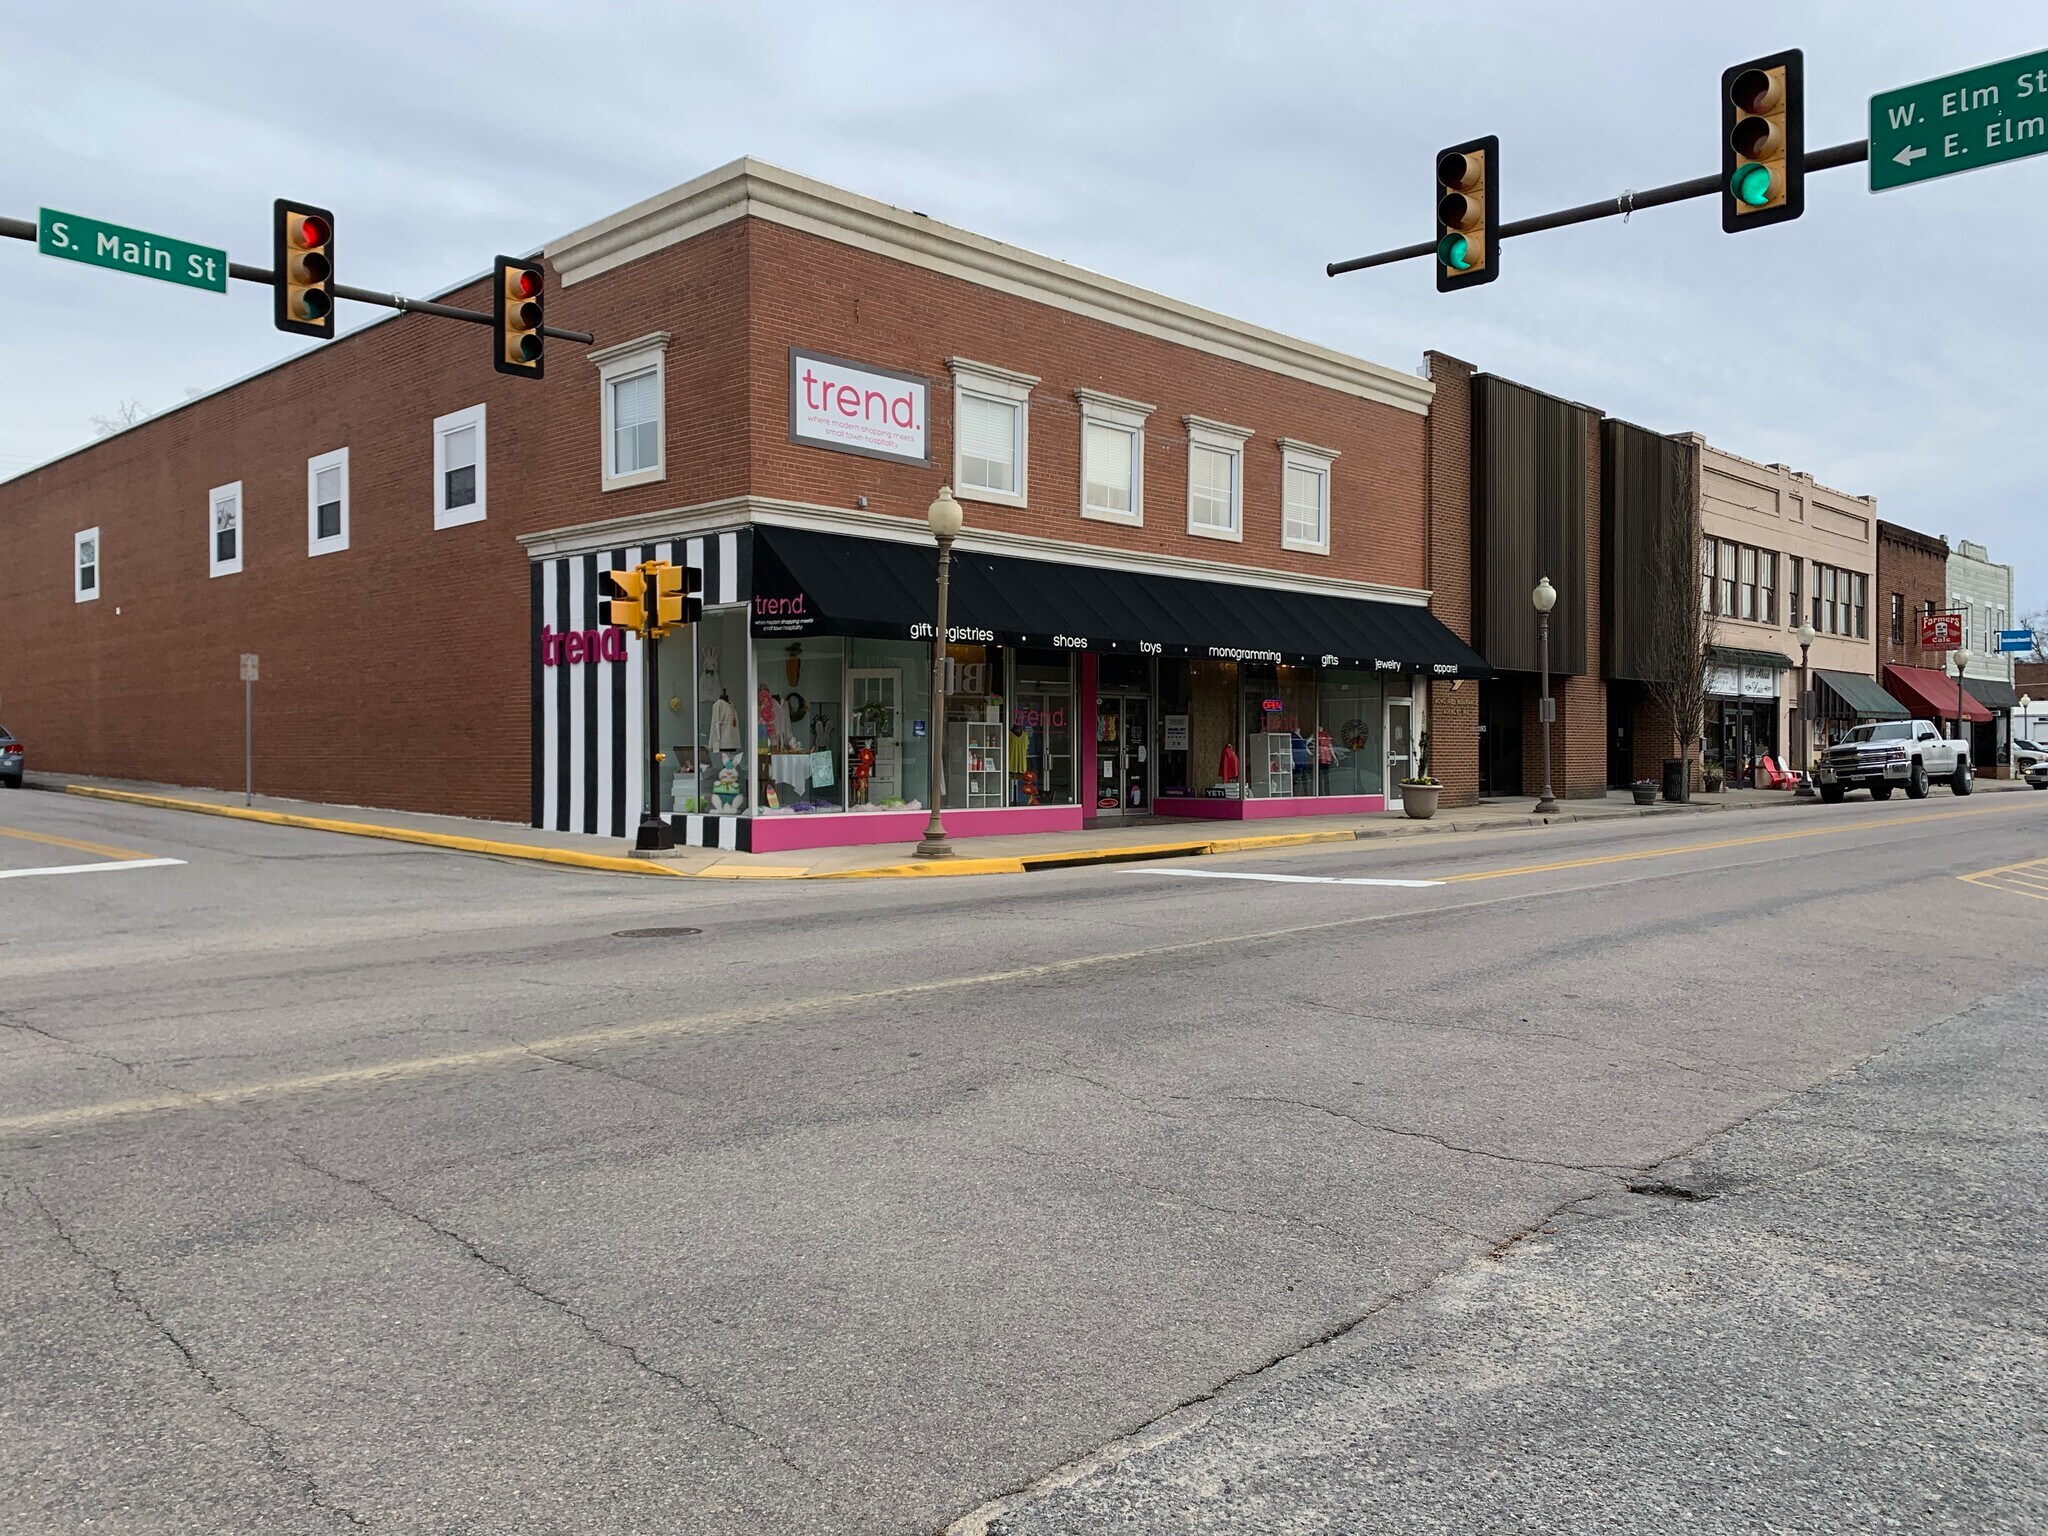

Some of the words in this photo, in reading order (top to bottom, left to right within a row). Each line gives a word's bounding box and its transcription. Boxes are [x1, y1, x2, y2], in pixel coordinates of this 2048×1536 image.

[1888, 103, 1925, 130] W.
[1942, 85, 1999, 117] Elm
[2017, 69, 2048, 98] St
[1944, 133, 1968, 158] E.
[1986, 116, 2045, 148] Elm
[51, 222, 79, 251] S.
[97, 232, 171, 272] Main
[188, 254, 216, 282] St
[802, 368, 921, 430] trend.
[825, 428, 845, 437] small
[846, 432, 864, 441] town
[865, 436, 898, 449] hospitality
[832, 420, 860, 431] modern
[861, 426, 893, 439] shopping
[893, 433, 915, 442] meets
[755, 593, 806, 615] trend.
[910, 622, 933, 639] gift
[1923, 616, 1960, 630] Farmers
[541, 624, 628, 667] trend.
[1053, 634, 1088, 649] shoes
[1140, 640, 1162, 656] toys
[1209, 646, 1281, 664] monogramming
[1321, 654, 1339, 667] gifts
[1375, 658, 1401, 673] jewelry
[1433, 663, 1458, 675] apparel
[1263, 701, 1281, 709] OPEN
[1206, 789, 1225, 797] YETI
